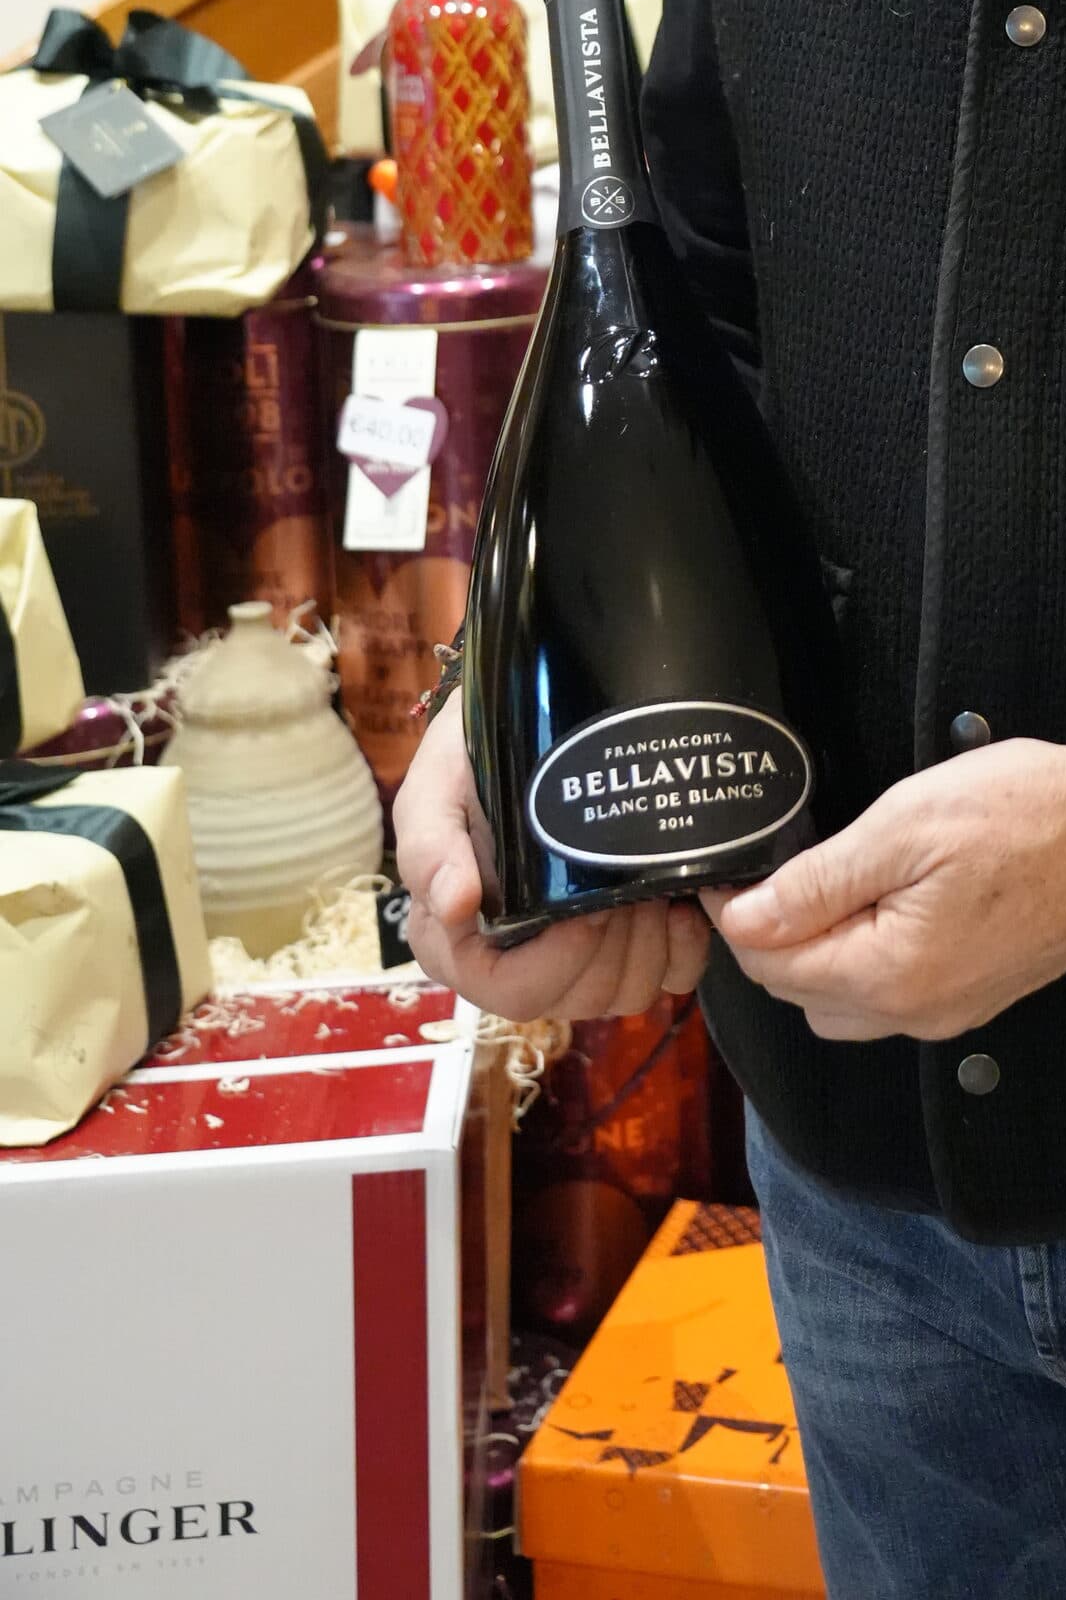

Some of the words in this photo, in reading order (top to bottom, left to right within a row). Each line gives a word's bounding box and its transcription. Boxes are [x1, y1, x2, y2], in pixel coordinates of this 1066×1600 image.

[579, 7, 612, 168] BELLAVISTA
[604, 732, 732, 760] FRANCIACORTA
[561, 751, 778, 802] BELLAVISTA
[583, 796, 648, 823] BLANC
[655, 792, 682, 809] DE
[689, 783, 764, 805] BLANCS
[659, 816, 694, 831] 2014
[0, 1470, 205, 1505] MPAGNE
[1, 1500, 258, 1556] LINGER
